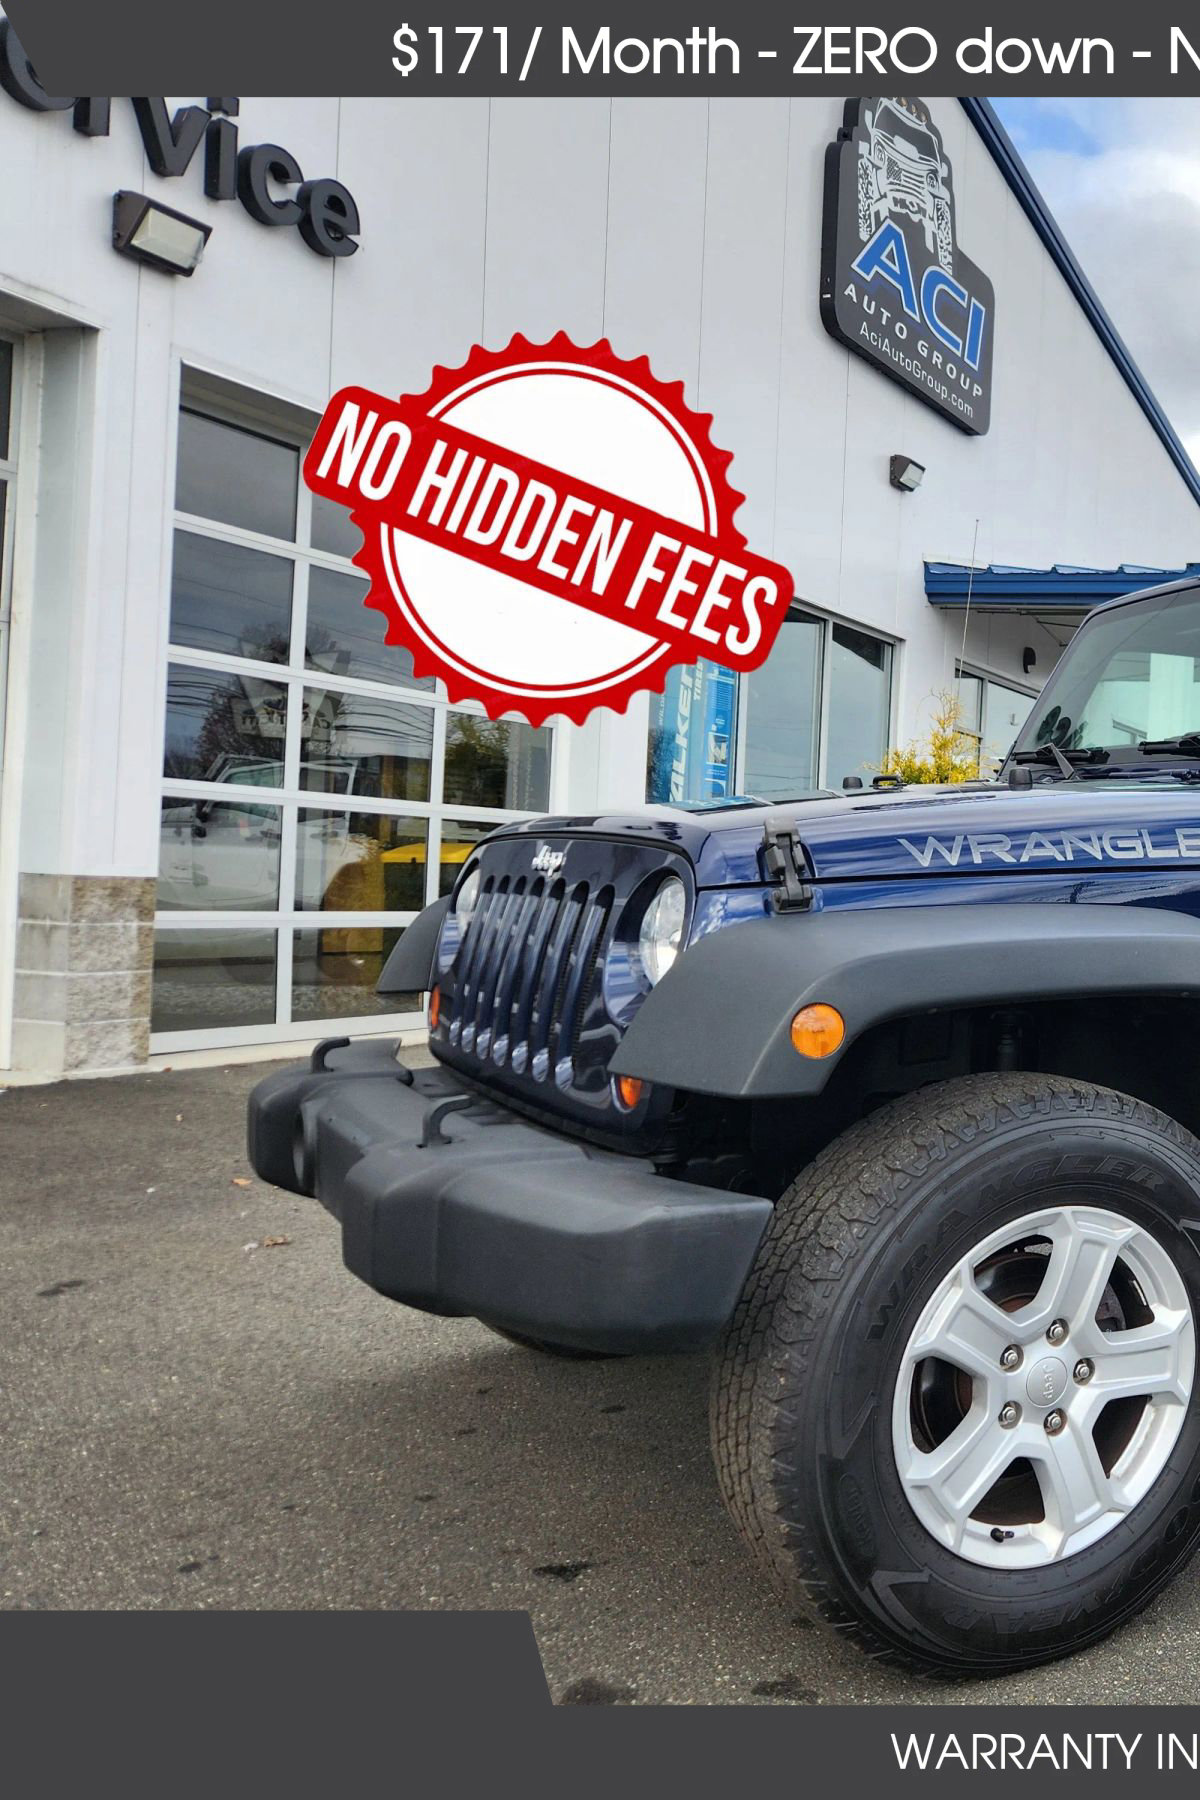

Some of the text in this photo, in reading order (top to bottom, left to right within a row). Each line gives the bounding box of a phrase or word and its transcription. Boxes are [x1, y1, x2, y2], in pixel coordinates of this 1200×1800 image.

[0, 15, 360, 257] vice
[844, 283, 984, 398] AUTO GROUP
[851, 218, 986, 372] ACI
[859, 321, 974, 419] AciAutoGroup.com
[1042, 1364, 1055, 1399] Jeep
